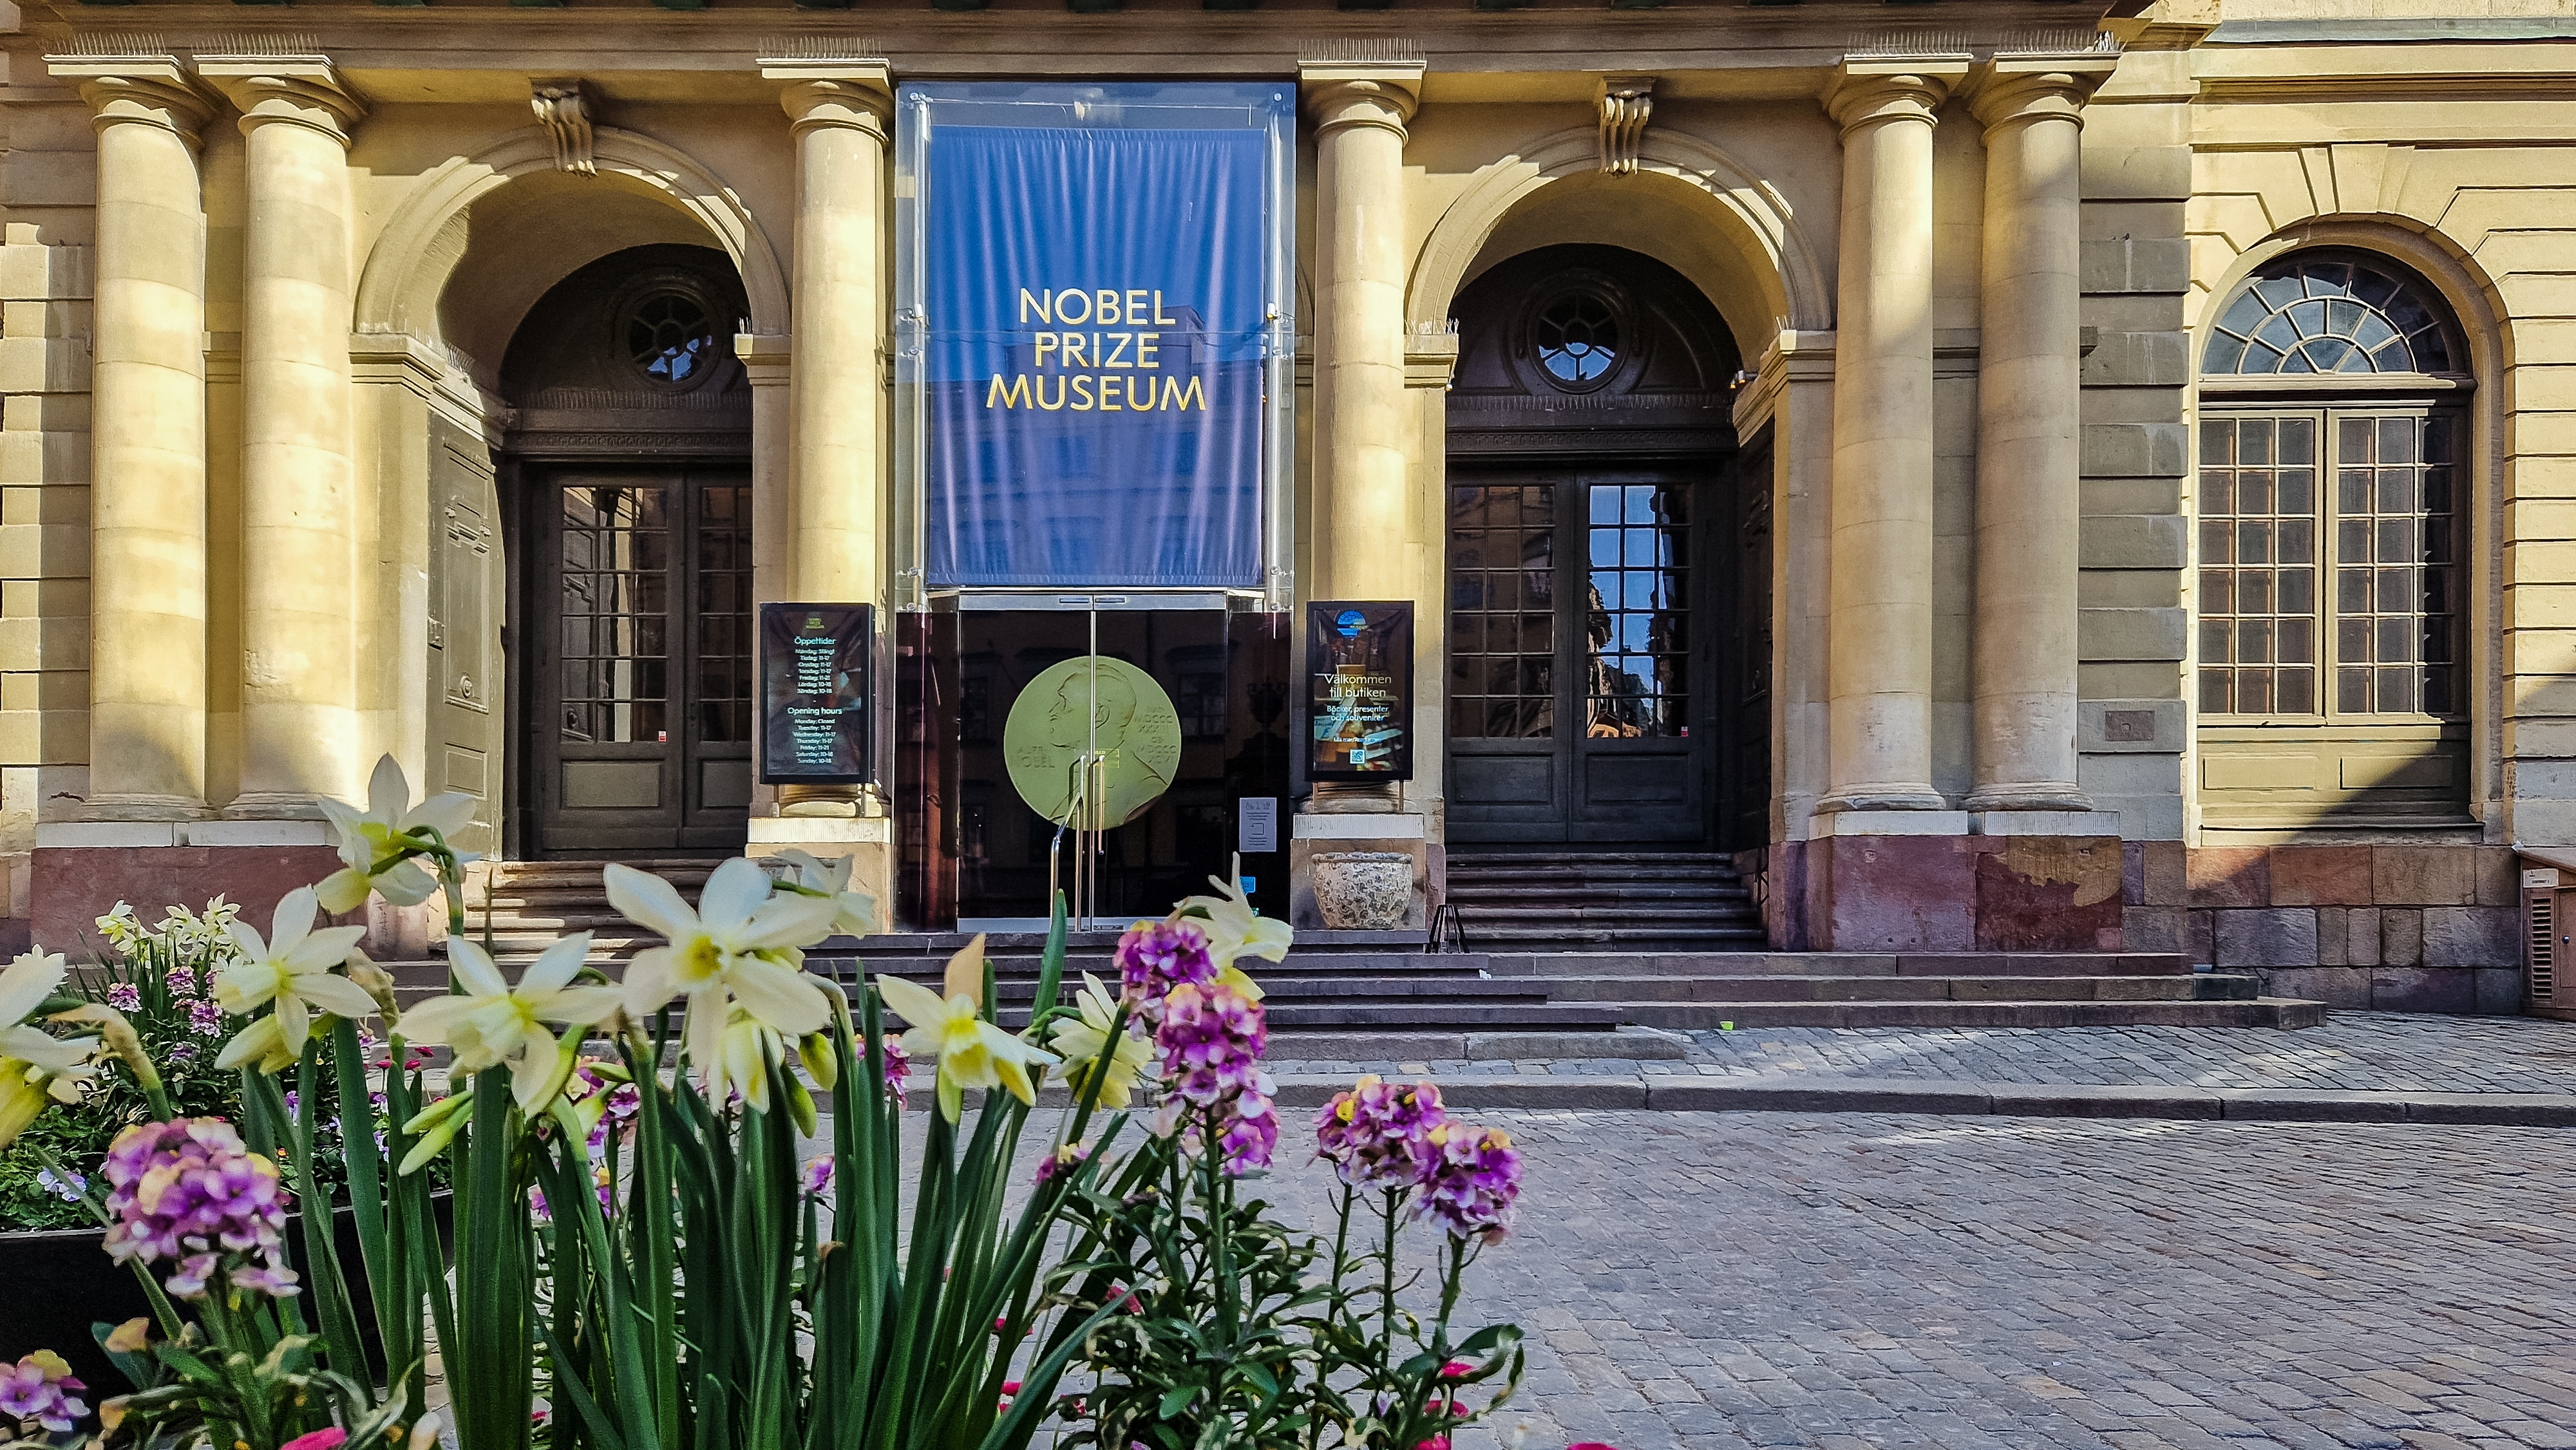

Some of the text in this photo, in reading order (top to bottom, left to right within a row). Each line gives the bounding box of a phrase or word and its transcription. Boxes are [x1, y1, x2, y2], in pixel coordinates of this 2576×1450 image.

[1020, 288, 1176, 325] NOBEL
[1034, 332, 1160, 369] PRIZE
[986, 373, 1207, 411] MUSEUM
[794, 636, 837, 646] Öppettider
[1324, 673, 1392, 684] Välkommen
[1329, 686, 1386, 697] till butiken
[787, 706, 843, 716] Opening hours
[1327, 705, 1389, 715] Böcker, presenter
